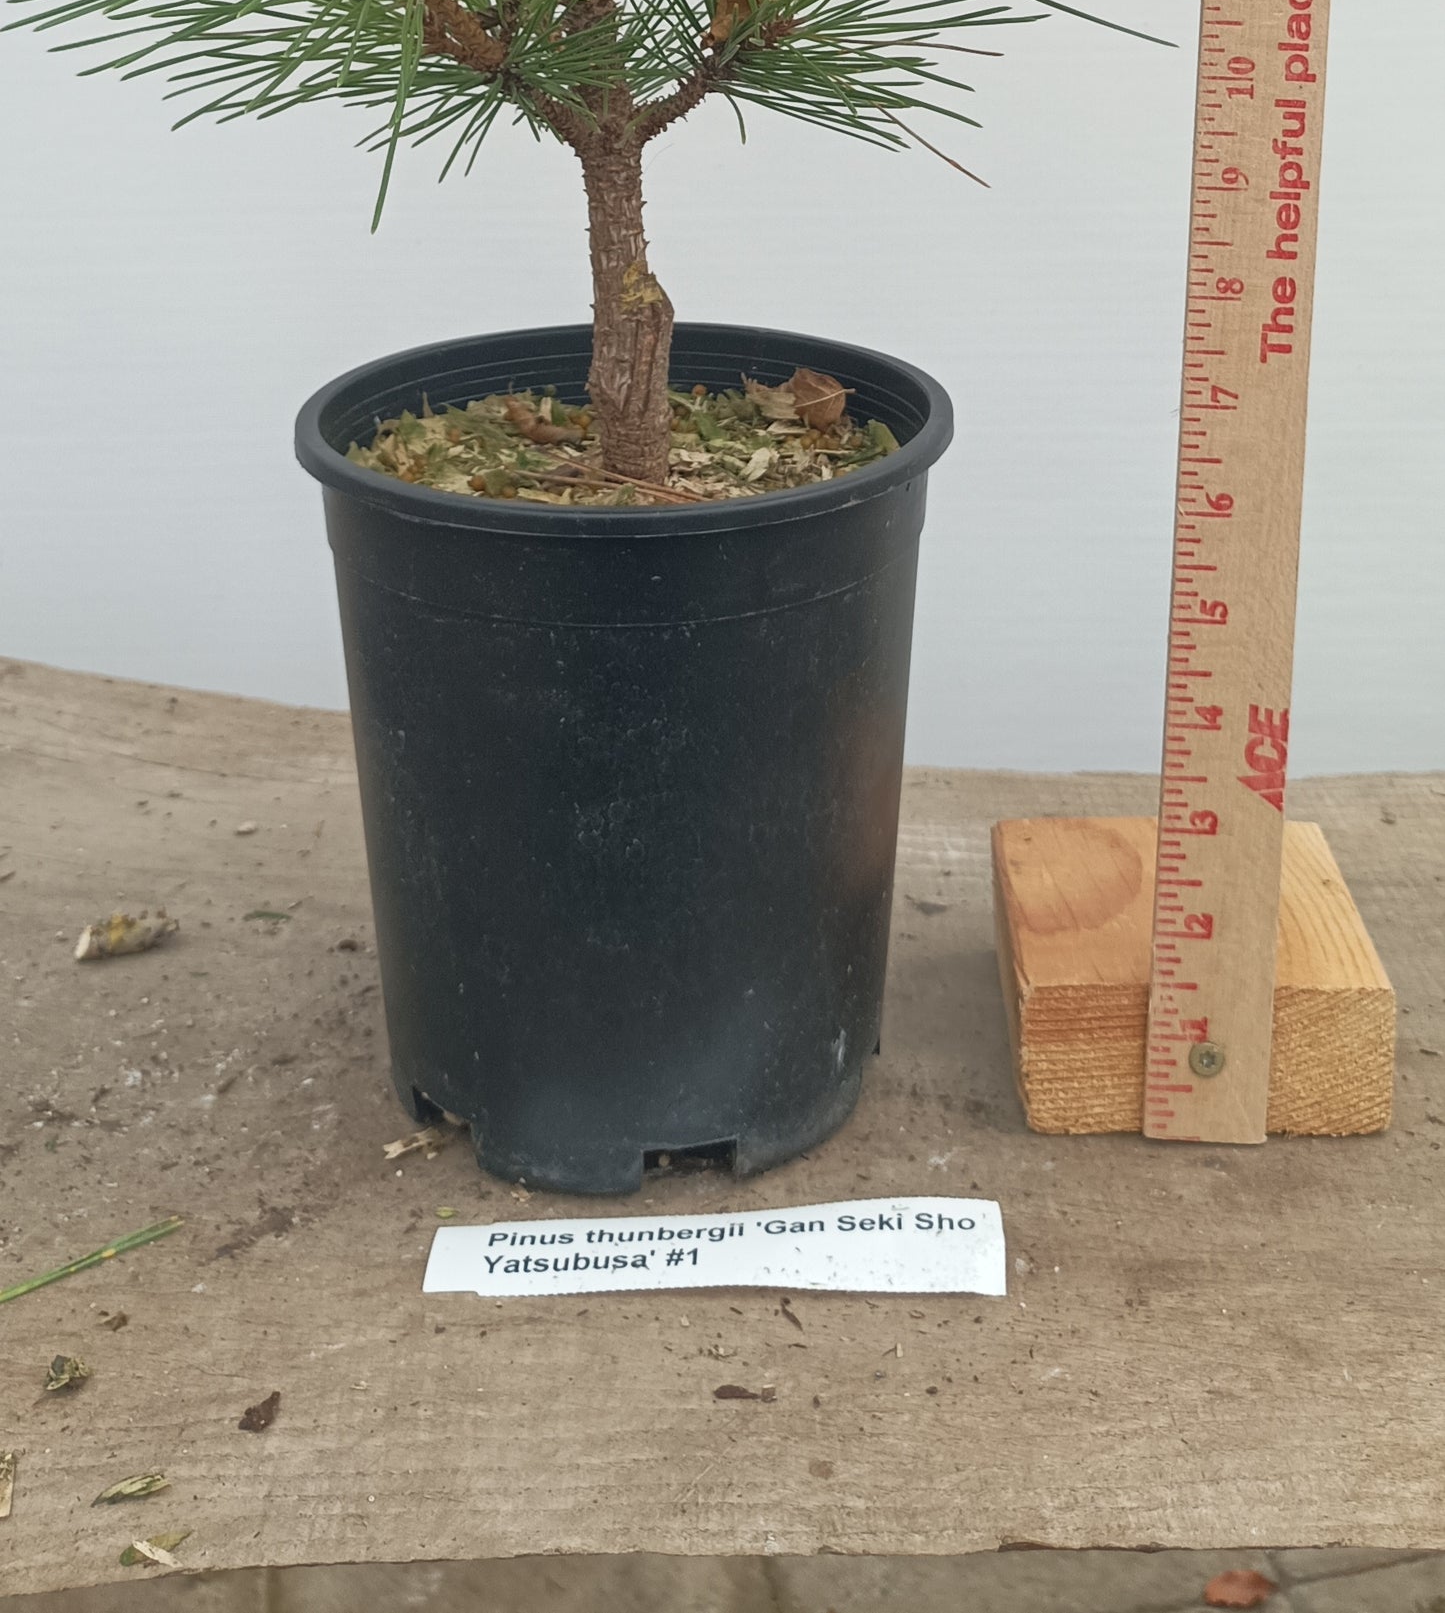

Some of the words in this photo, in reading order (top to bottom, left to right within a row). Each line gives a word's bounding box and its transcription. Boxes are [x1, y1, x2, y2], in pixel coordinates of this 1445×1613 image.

[1226, 56, 1256, 100] 10
[1220, 167, 1249, 187] 9
[1266, 98, 1311, 260] helpful
[1215, 276, 1245, 296] 8
[1260, 276, 1297, 364] The
[1210, 385, 1239, 406] 7
[1205, 492, 1235, 512] 6
[1200, 600, 1229, 621] 5
[1194, 705, 1224, 726] 4
[1235, 703, 1290, 812] ACE
[1189, 811, 1219, 832] 3
[1184, 913, 1214, 935] 2
[1180, 1015, 1211, 1034] 1
[488, 1230, 574, 1248] Pinus
[586, 1222, 746, 1245] thunbergii
[756, 1216, 825, 1234] 'Gan
[836, 1212, 903, 1232] Seki
[914, 1212, 976, 1231] Sho
[483, 1250, 656, 1275] Yatsubusa'
[665, 1248, 700, 1266] #1
